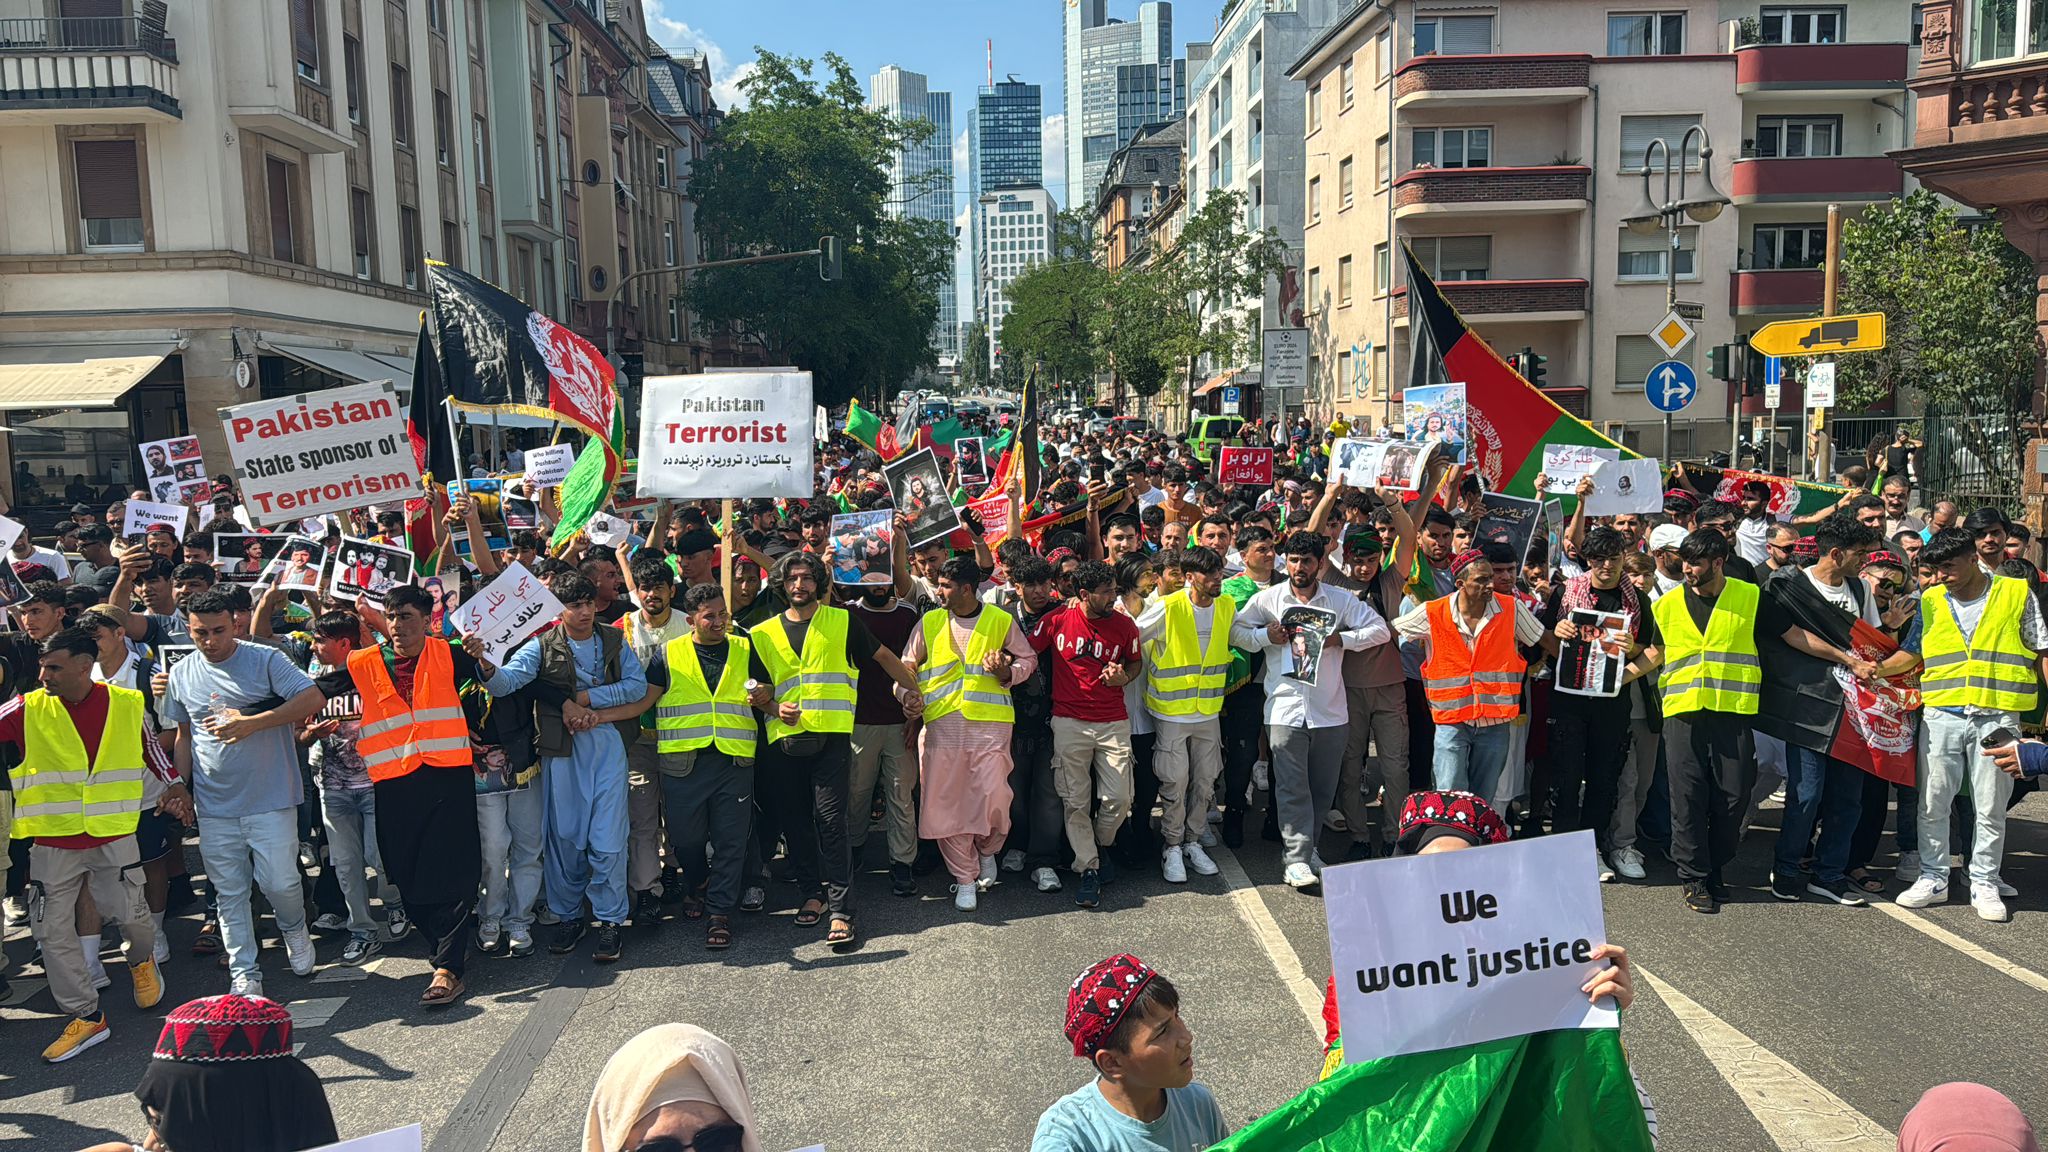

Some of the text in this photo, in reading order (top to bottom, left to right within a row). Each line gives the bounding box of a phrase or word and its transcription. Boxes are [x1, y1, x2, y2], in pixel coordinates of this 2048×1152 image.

[683, 396, 765, 413] Pakistan
[1228, 390, 1236, 400] P
[231, 398, 393, 443] Pakistan
[665, 420, 787, 444] Terrorist
[245, 434, 398, 479] State sponsor of
[252, 471, 411, 514] Terrorism
[135, 509, 179, 522] We want
[1440, 890, 1498, 924] We
[1356, 937, 1593, 994] want justice
